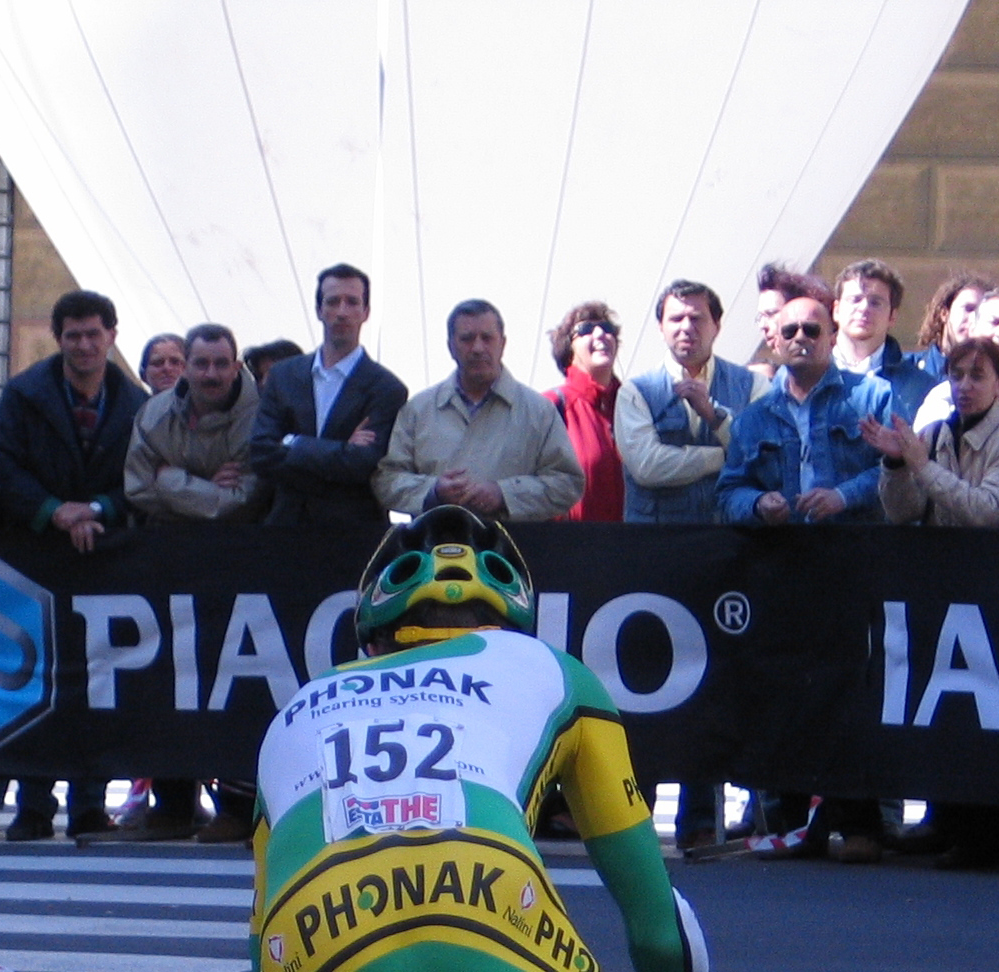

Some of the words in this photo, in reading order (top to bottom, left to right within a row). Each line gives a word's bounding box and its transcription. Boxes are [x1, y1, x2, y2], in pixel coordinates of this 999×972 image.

[72, 592, 708, 713] PIAIO
[285, 667, 493, 727] PHONAK
[311, 695, 382, 719] hearing
[389, 691, 464, 707] systems
[324, 718, 458, 789] 152
[295, 861, 505, 957] PHONAK
